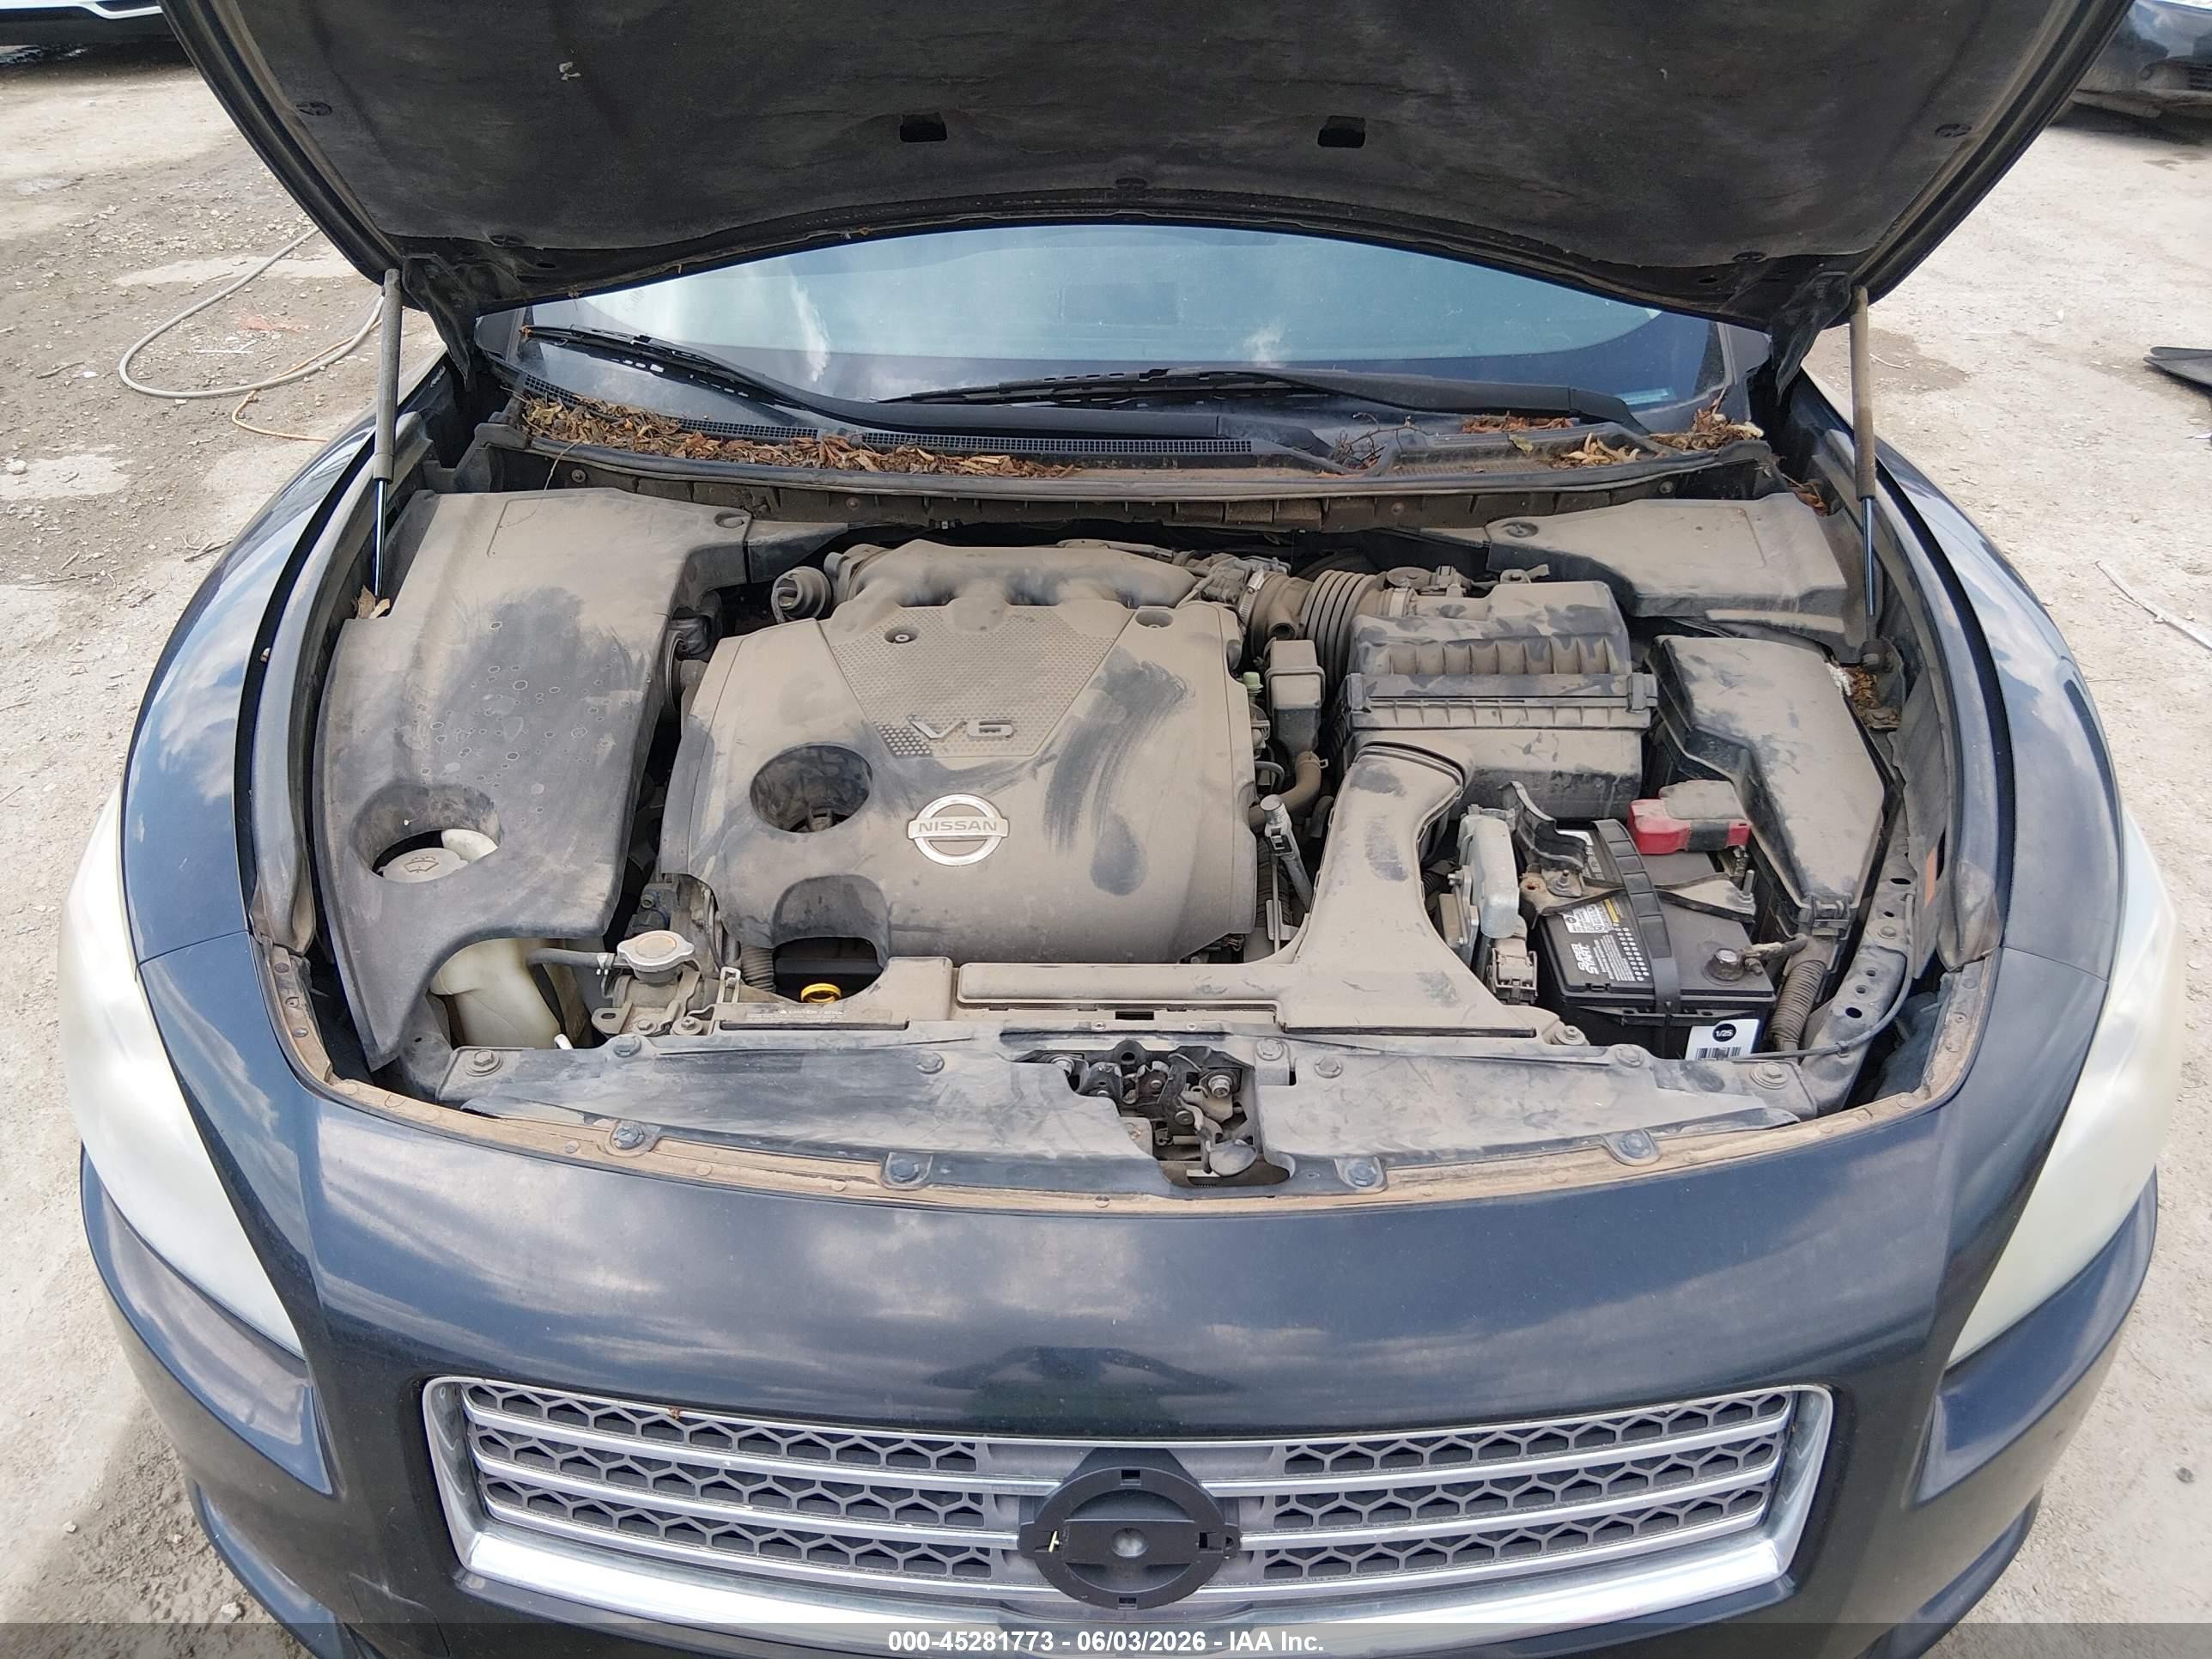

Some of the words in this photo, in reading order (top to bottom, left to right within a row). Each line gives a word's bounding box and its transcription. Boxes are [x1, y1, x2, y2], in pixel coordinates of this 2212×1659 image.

[908, 718, 1015, 739] V6
[919, 821, 997, 833] NISSAN
[1578, 945, 1599, 975] START
